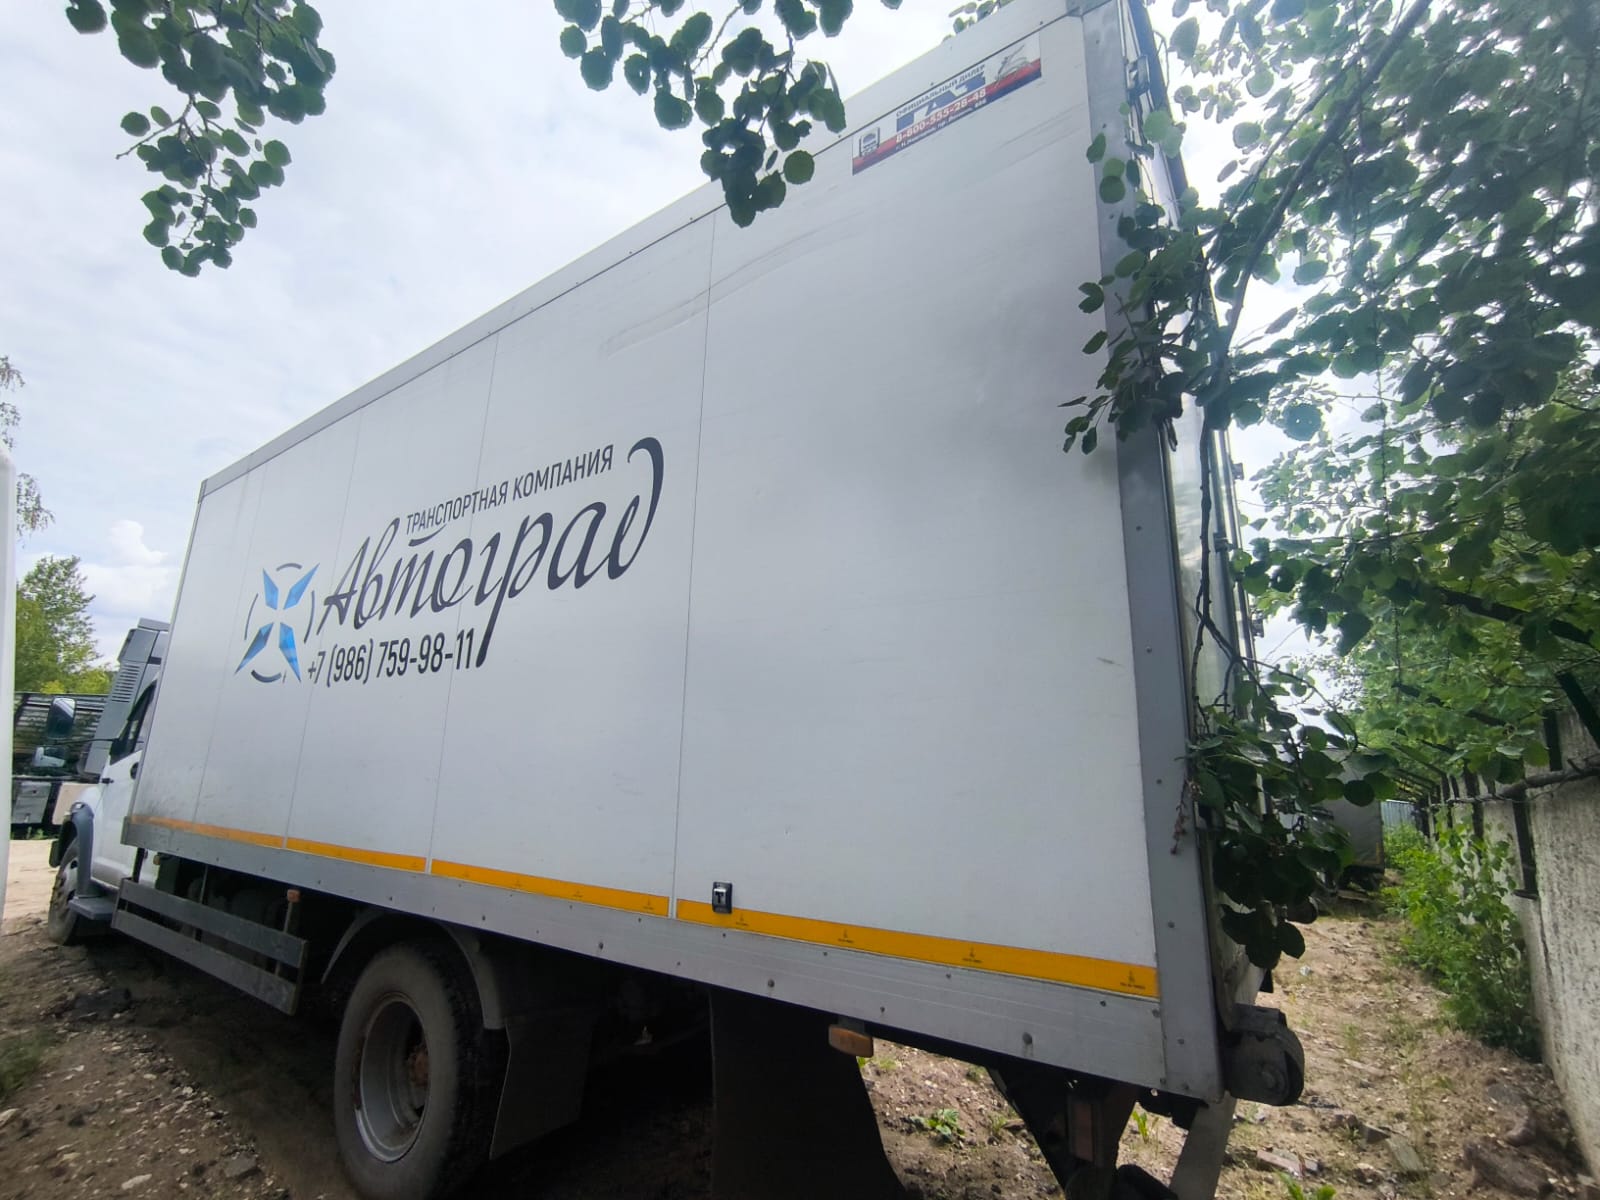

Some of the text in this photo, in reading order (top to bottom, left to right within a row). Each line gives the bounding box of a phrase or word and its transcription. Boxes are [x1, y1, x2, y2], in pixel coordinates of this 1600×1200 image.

[959, 64, 985, 83] ДИЛЕР
[406, 444, 614, 535] ТРАНСПОРТНАЯ КОМПАНИЯ
[316, 436, 664, 668] Автоград
[307, 627, 475, 688] +7 (986) 759-98-11
